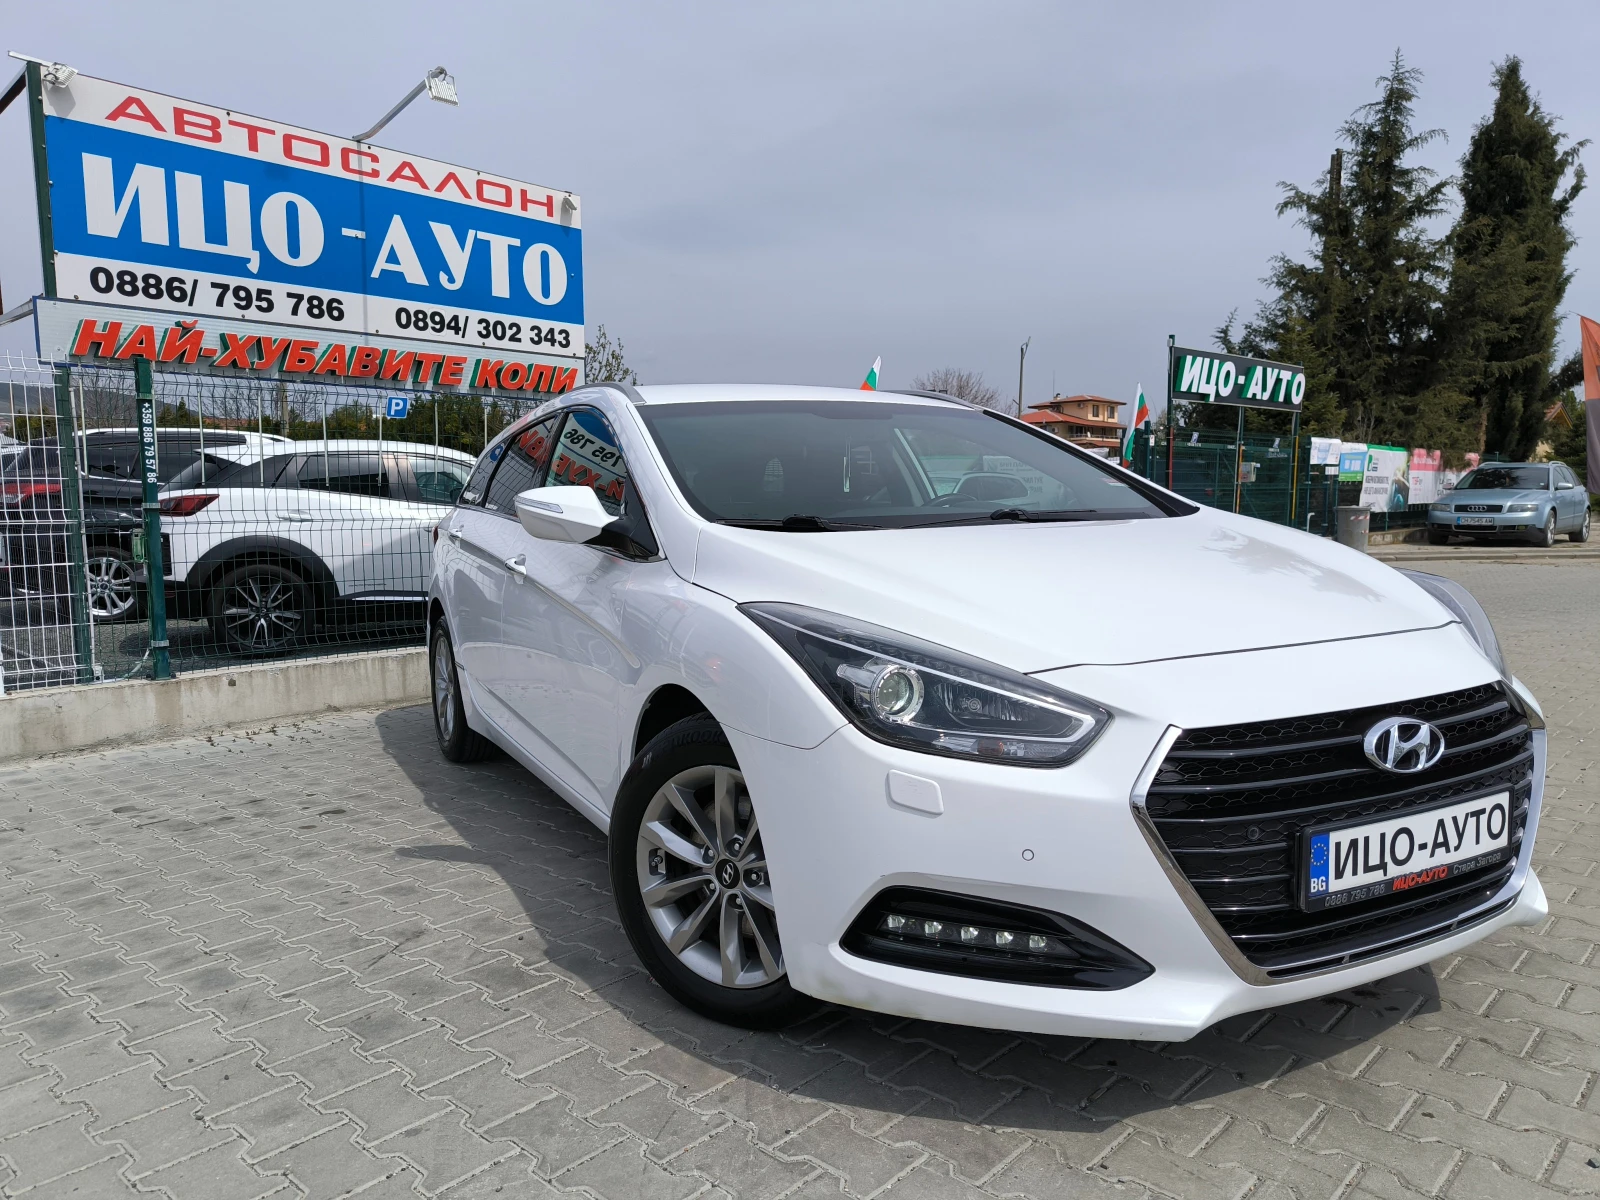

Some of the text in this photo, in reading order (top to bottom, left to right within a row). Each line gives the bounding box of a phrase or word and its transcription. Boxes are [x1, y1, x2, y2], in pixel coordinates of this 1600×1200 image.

[107, 97, 555, 218] АВТОСАЛОН
[89, 266, 345, 322] 0886/ 795 786
[395, 307, 571, 349] 0894/ 302 343
[72, 319, 579, 394] НАЙ-ХУБАВИТЕ КОЛИ
[390, 398, 404, 416] P
[142, 402, 157, 483] +359 886 79 57 86
[1334, 802, 1506, 881] ИЦО-АУТО
[1310, 876, 1327, 893] BG
[1393, 865, 1448, 891] ИЦО-АУТО
[1453, 860, 1476, 875] Стара
[1324, 883, 1386, 907] 0886 795 786
